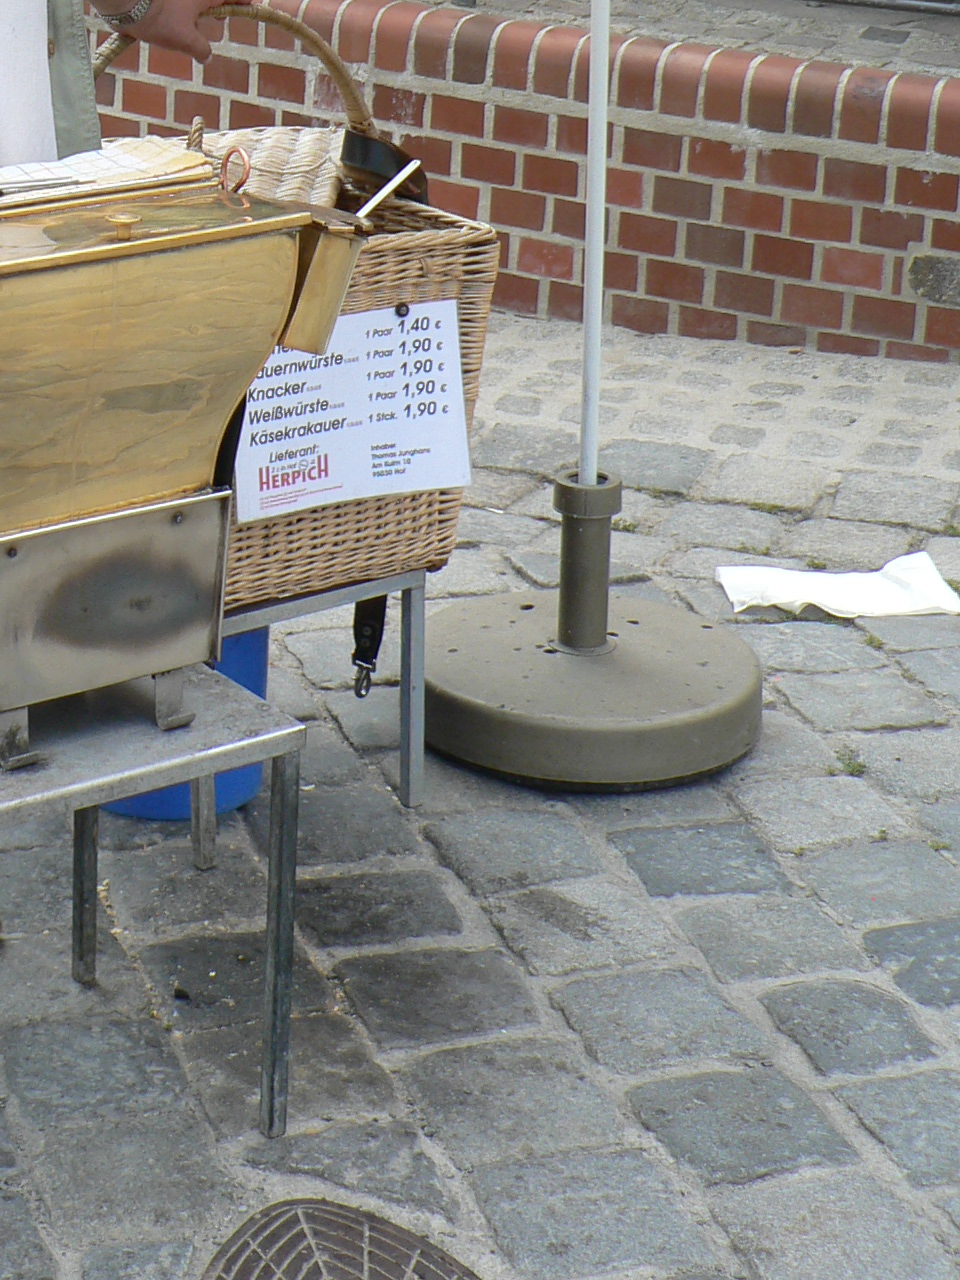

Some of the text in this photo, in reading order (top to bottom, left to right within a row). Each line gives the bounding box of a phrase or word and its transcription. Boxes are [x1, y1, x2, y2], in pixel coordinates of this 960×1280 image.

[372, 327, 394, 338] Paar
[398, 316, 430, 336] 1,40
[247, 381, 307, 403] Knacker
[373, 370, 395, 380] Paar
[400, 358, 433, 377] 1,90
[255, 352, 344, 380] auernwürste
[373, 349, 394, 359] Paar
[399, 337, 431, 357] 1,90
[248, 398, 330, 426] Weißwürste
[375, 391, 397, 401] Paar
[402, 380, 435, 398] 1,90
[249, 417, 347, 447] Käsekrakauer
[404, 401, 437, 420] 1,90
[269, 443, 320, 464] Lieferant:
